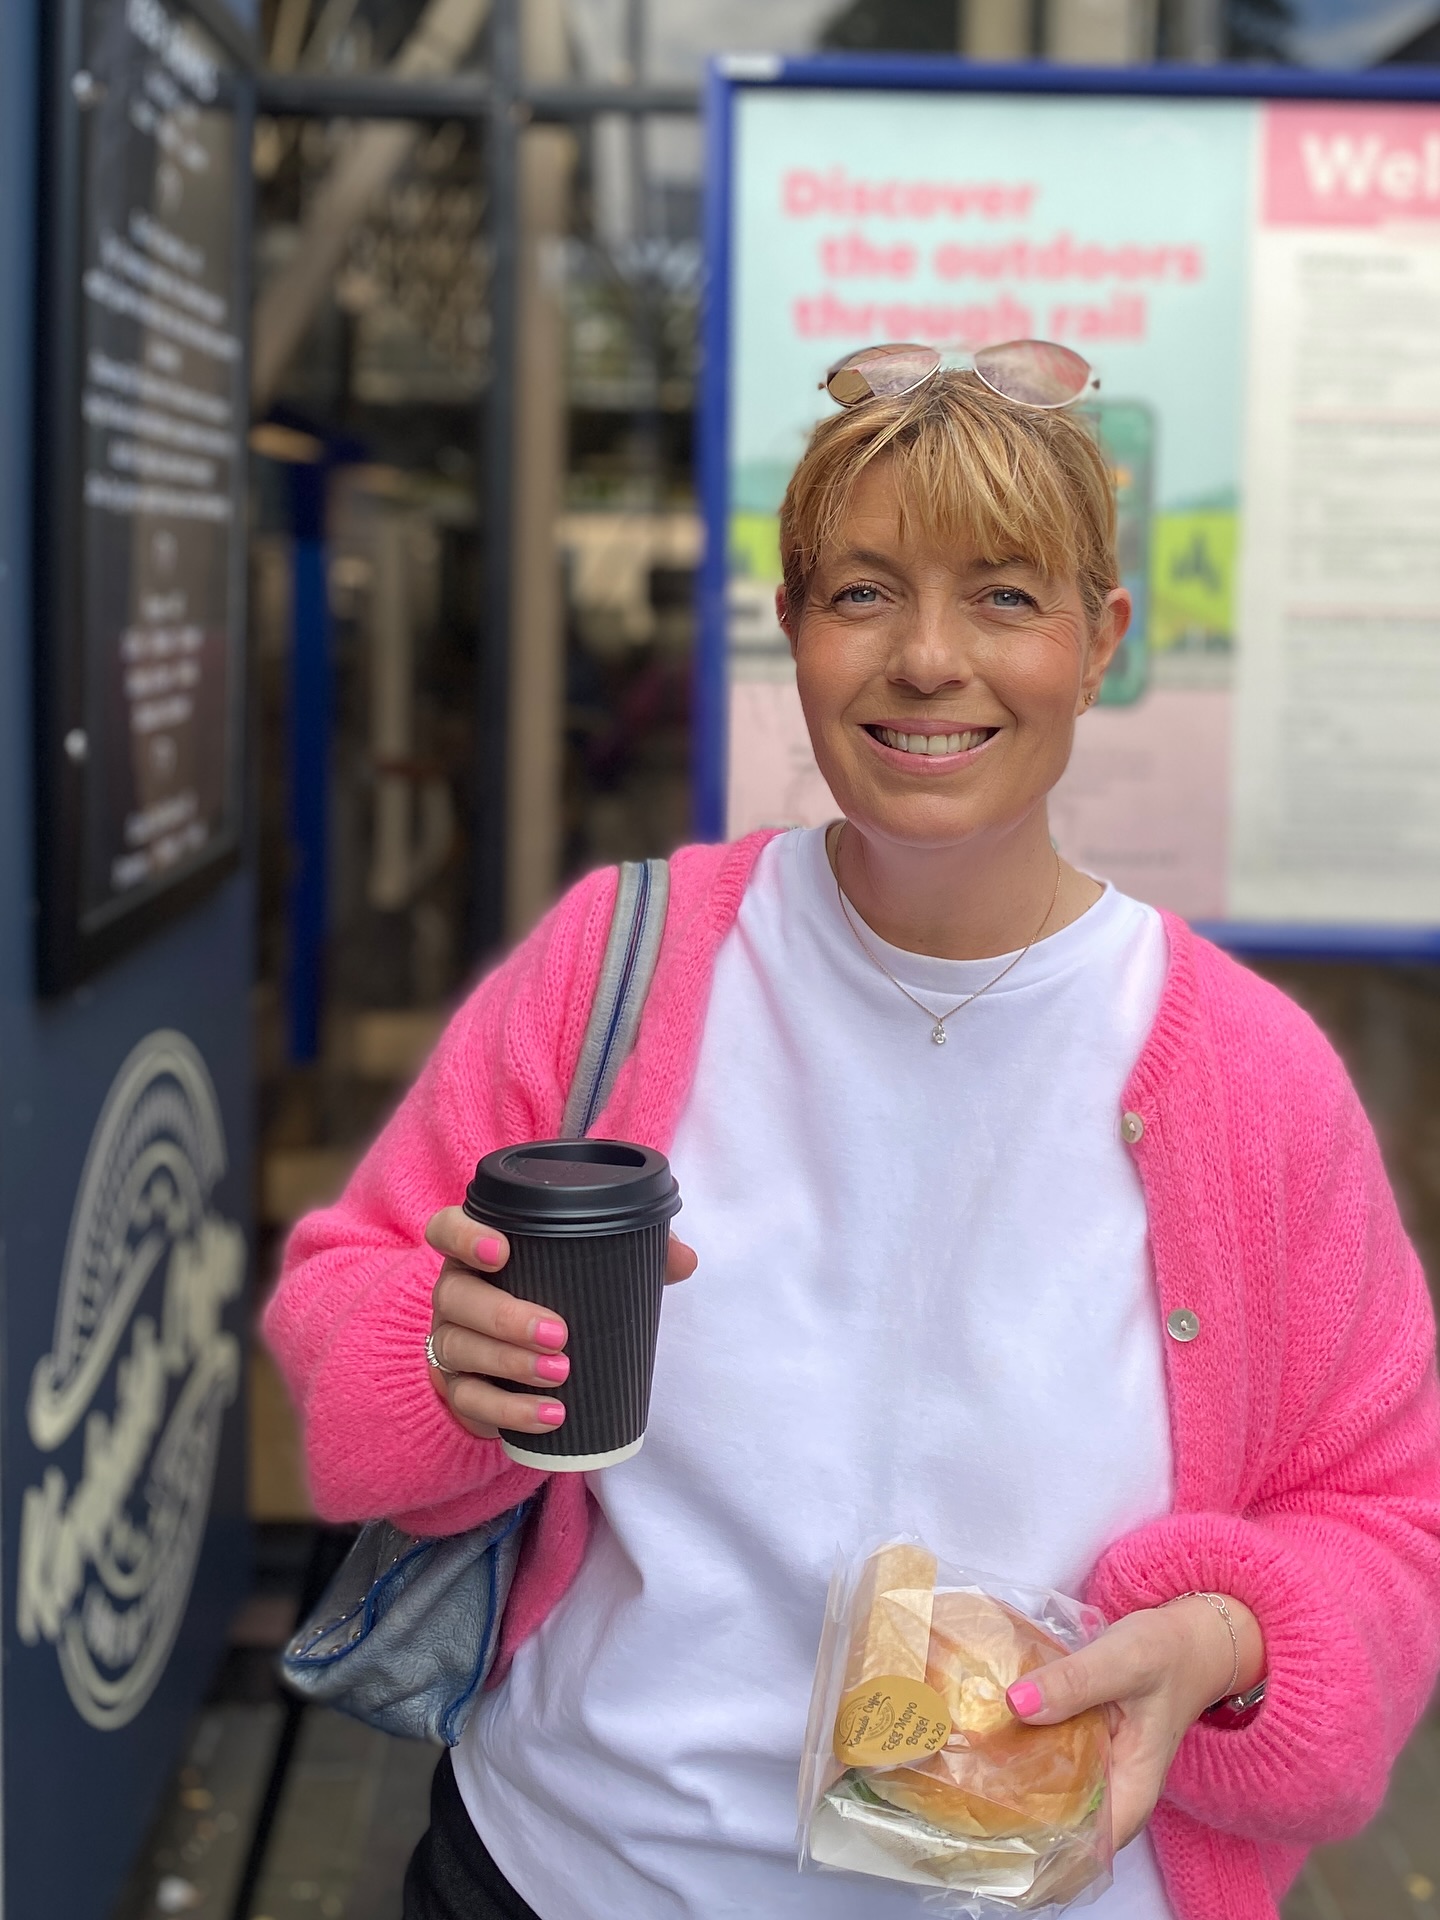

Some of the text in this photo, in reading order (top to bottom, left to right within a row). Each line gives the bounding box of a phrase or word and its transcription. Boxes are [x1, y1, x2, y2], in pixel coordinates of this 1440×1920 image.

[1300, 132, 1440, 200] Wel
[781, 167, 1036, 220] Discover
[819, 230, 1204, 284] the outdoors
[793, 291, 1147, 348] through rail
[846, 1715, 871, 1748] Kerbside
[862, 1691, 883, 1714] Coffee
[881, 1723, 904, 1751] Egg
[897, 1701, 918, 1731] Mayo
[905, 1716, 930, 1746] Bagel
[924, 1722, 947, 1751] £4.20
